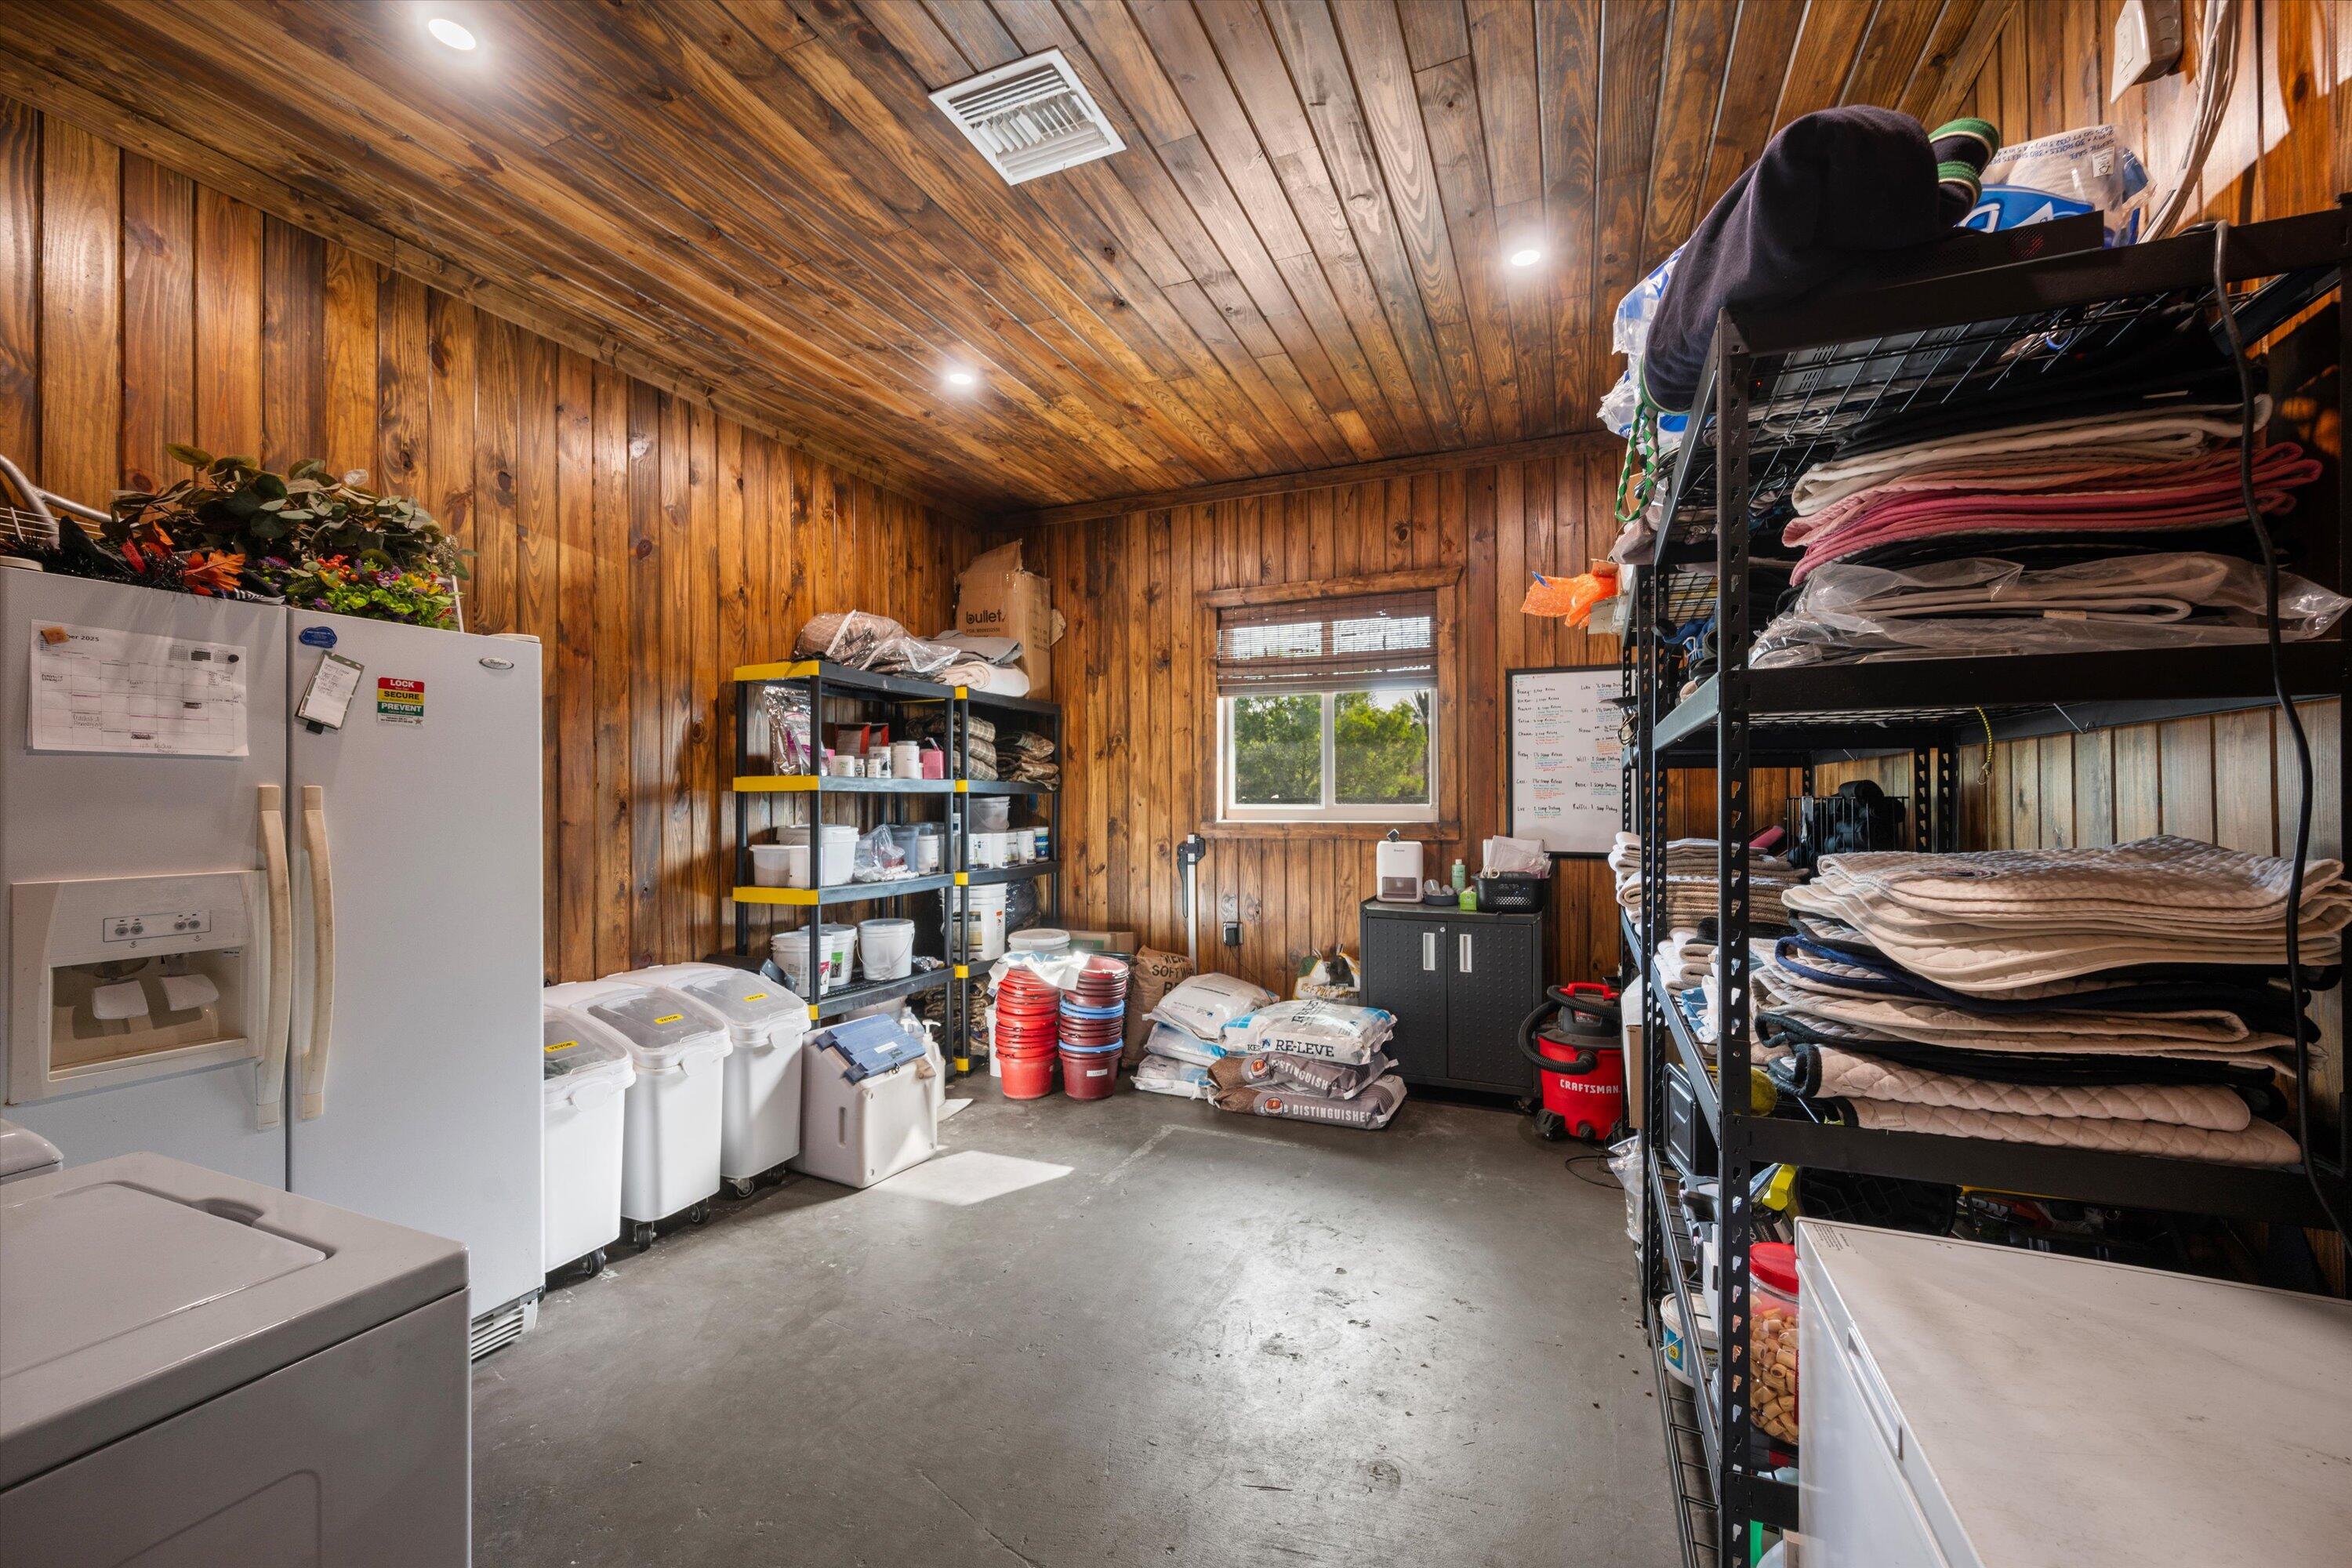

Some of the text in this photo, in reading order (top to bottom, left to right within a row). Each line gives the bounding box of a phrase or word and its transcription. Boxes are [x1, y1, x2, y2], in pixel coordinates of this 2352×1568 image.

[2069, 138, 2114, 160] SEPTIC SAFE
[390, 679, 415, 688] LOCK
[384, 691, 419, 700] SECURE
[381, 702, 422, 712] PREVENT
[1152, 964, 1179, 978] SOFT
[1275, 1039, 1335, 1058] RE-LEVE
[1559, 1079, 1619, 1094] CRAFTSMAN
[1293, 1104, 1372, 1123] DISTINGUISHED
